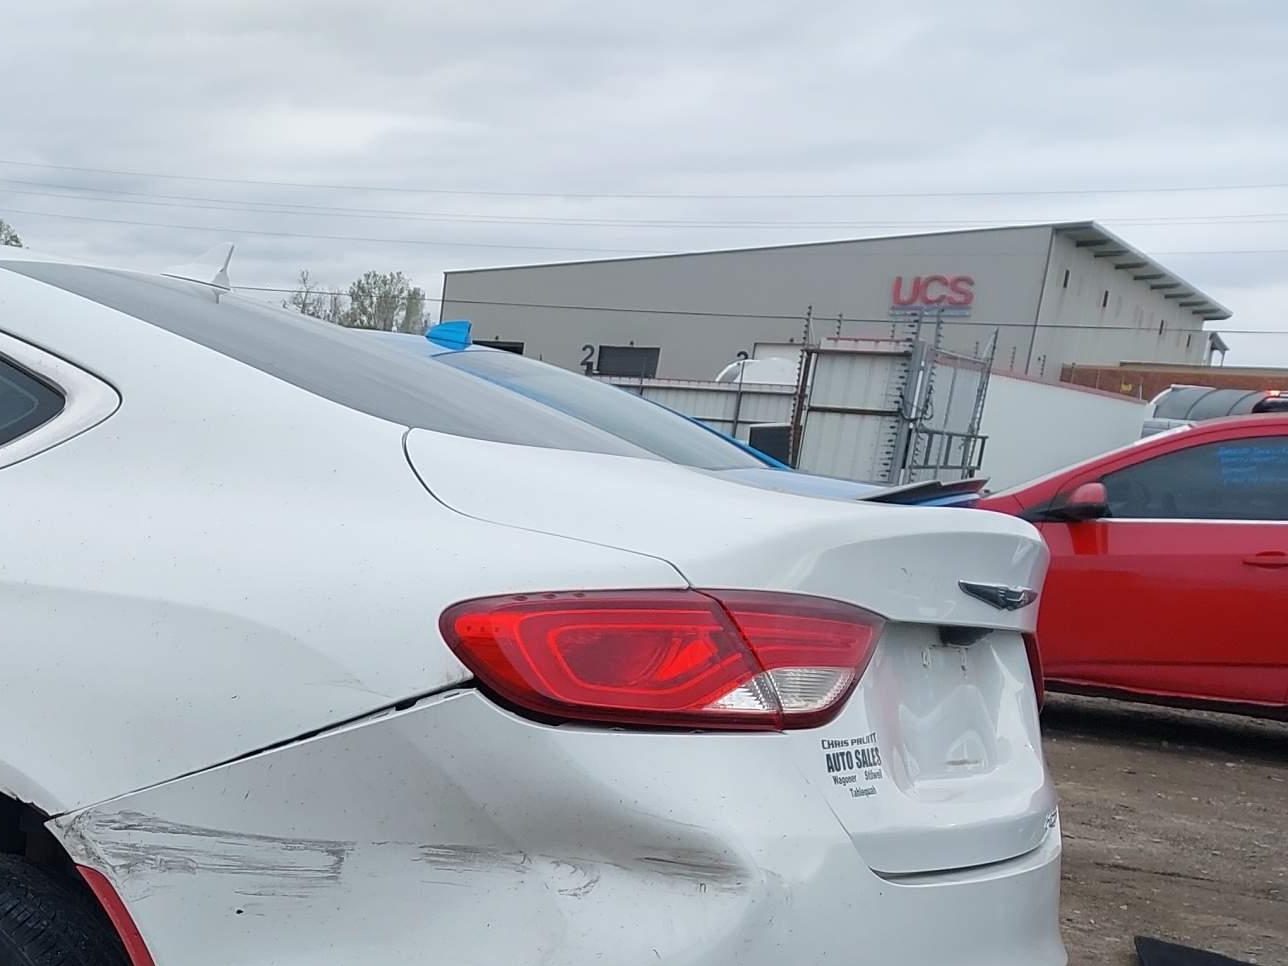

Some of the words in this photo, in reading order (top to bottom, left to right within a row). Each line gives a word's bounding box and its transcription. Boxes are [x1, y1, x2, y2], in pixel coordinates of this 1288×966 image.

[892, 275, 975, 305] UCS
[580, 344, 595, 366] 2
[821, 739, 849, 750] CHRIS
[850, 732, 877, 746] PRUITT
[825, 750, 854, 773] AUTO
[854, 747, 882, 769] SALES
